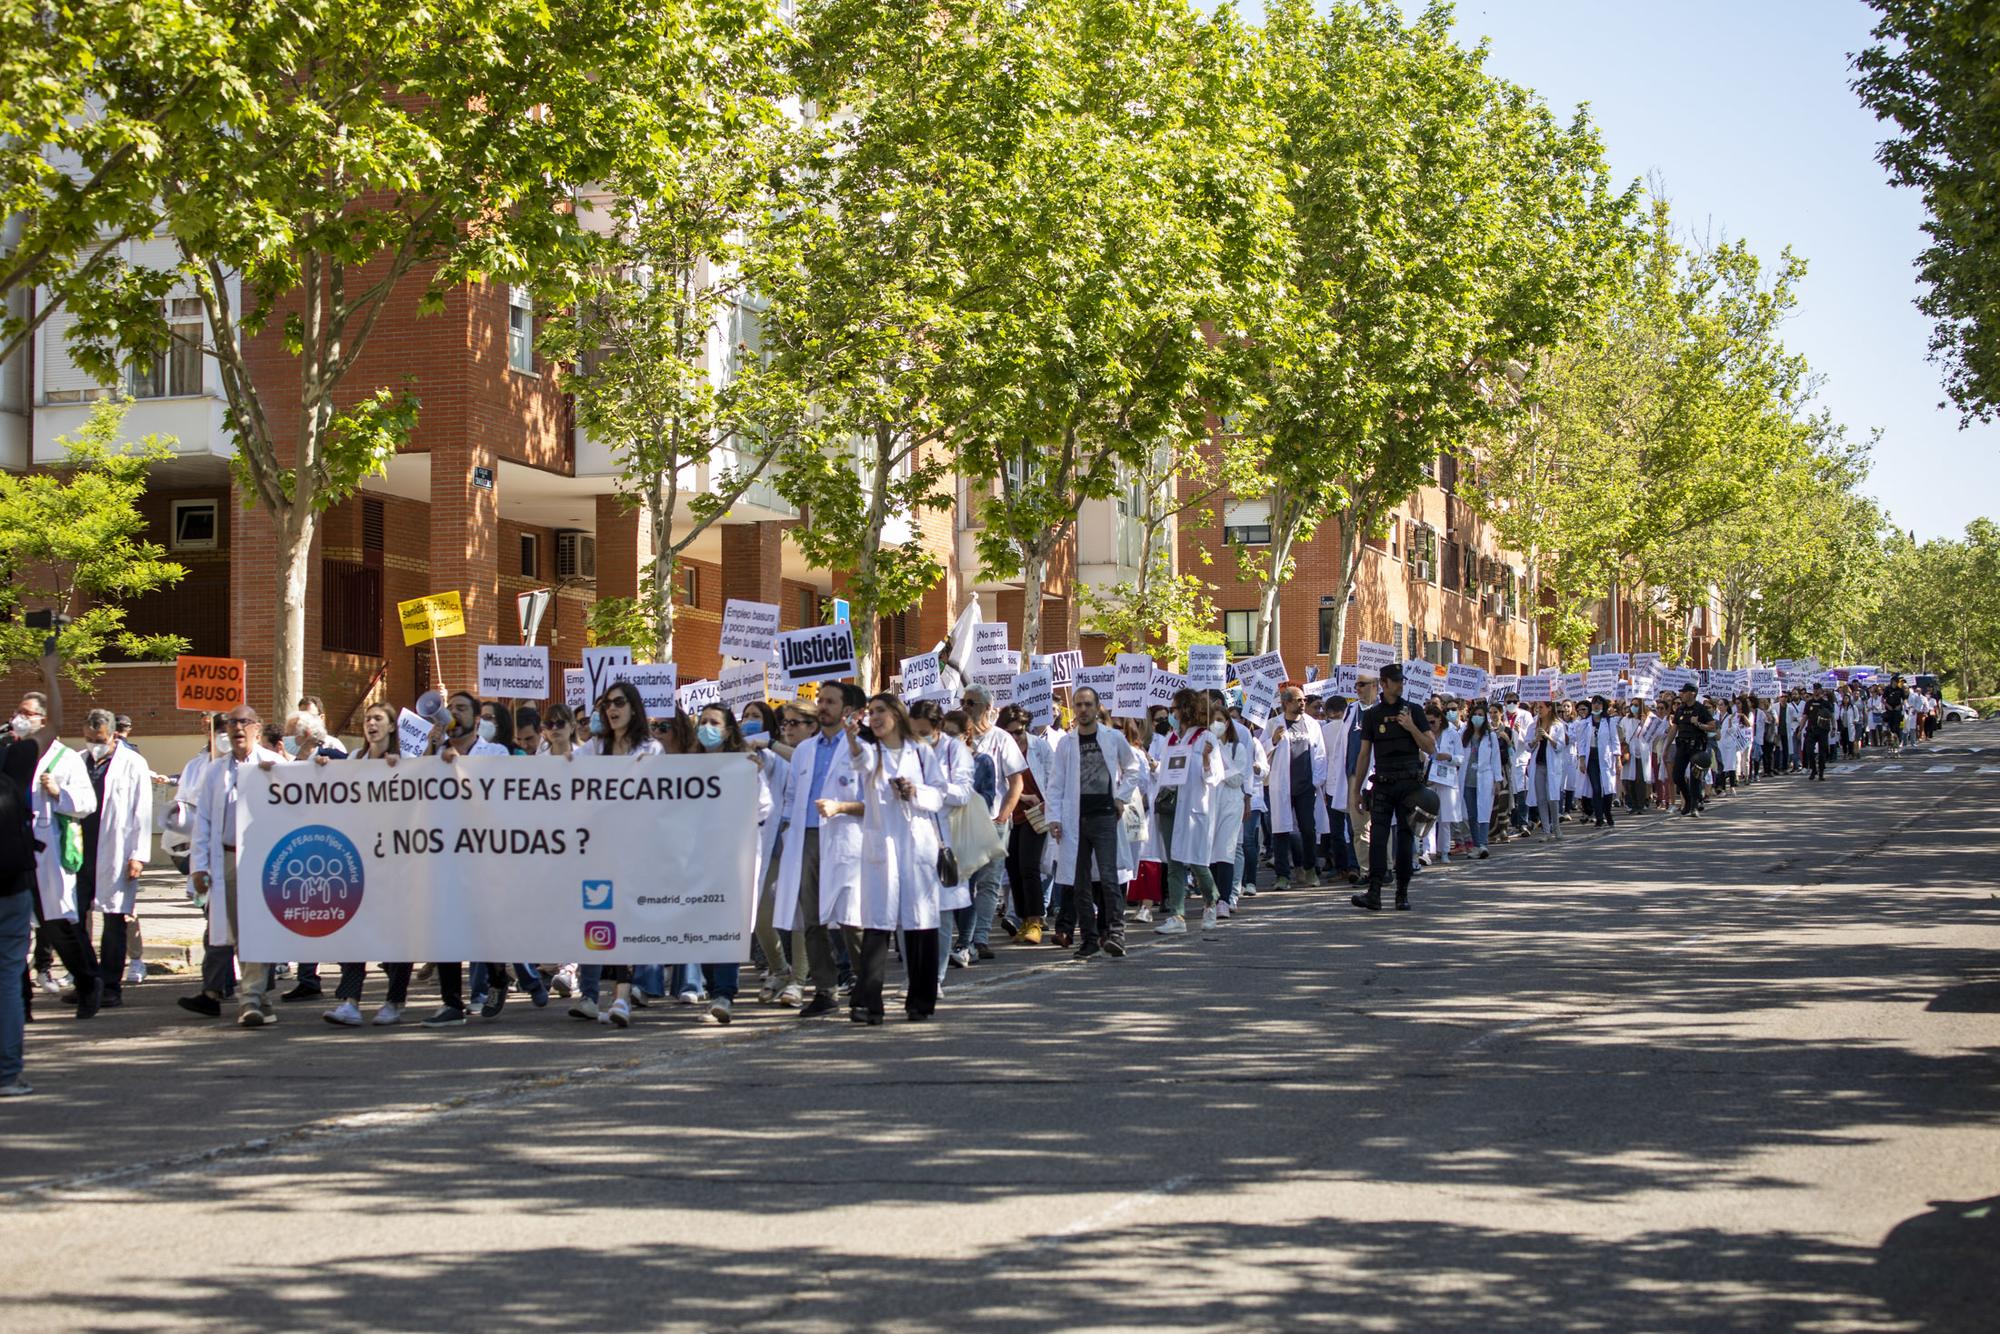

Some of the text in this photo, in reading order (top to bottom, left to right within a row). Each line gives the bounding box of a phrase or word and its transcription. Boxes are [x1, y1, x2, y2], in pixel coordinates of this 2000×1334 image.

[726, 607, 776, 621] Empleo basura
[729, 623, 745, 633] poco
[745, 624, 776, 636] personal
[977, 629, 1004, 642] ¡No más
[743, 638, 750, 647] tu
[781, 630, 854, 670] ¡Justicia!
[976, 643, 1007, 652] contratos
[484, 652, 543, 670] ¡Más sanitarios,
[904, 657, 938, 678] ¡AYUSO,
[980, 655, 1004, 665] basura!
[1053, 652, 1080, 681] ASTA!
[180, 664, 242, 683] ¡AYUSO,
[1131, 663, 1145, 673] más
[483, 675, 545, 691] muy necesarios!
[567, 675, 585, 684] Emp
[633, 671, 673, 687] sanitarios,
[906, 672, 939, 692] ABUSO!
[1017, 676, 1047, 696] ¡No más
[1075, 671, 1115, 687] ¡Más sanitari
[1116, 682, 1147, 691] contratos
[1151, 675, 1187, 690] ¡AYUS
[182, 685, 242, 702] ABUSO!
[572, 687, 585, 696] poc
[684, 687, 721, 705] ¡AYUS
[1150, 688, 1175, 700] ABU
[642, 693, 673, 707] esarios!
[1118, 697, 1142, 708] basura!
[1031, 706, 1049, 718] sura!
[401, 718, 421, 738] Menor
[400, 738, 413, 752] ejor
[268, 773, 721, 805] SOMOS MÉDICOS Y FEAs PRECARIOS
[393, 828, 444, 854] NOS
[454, 828, 566, 854] AYUDAS
[269, 851, 289, 885] Médicos
[291, 834, 313, 849] FEAs
[326, 834, 343, 850] fijos
[343, 851, 360, 883] Madrid
[636, 893, 725, 906] @madrid_ope2021
[283, 907, 346, 923] #FijezaYa
[622, 932, 741, 944] medicos_no_fijos_madrid
